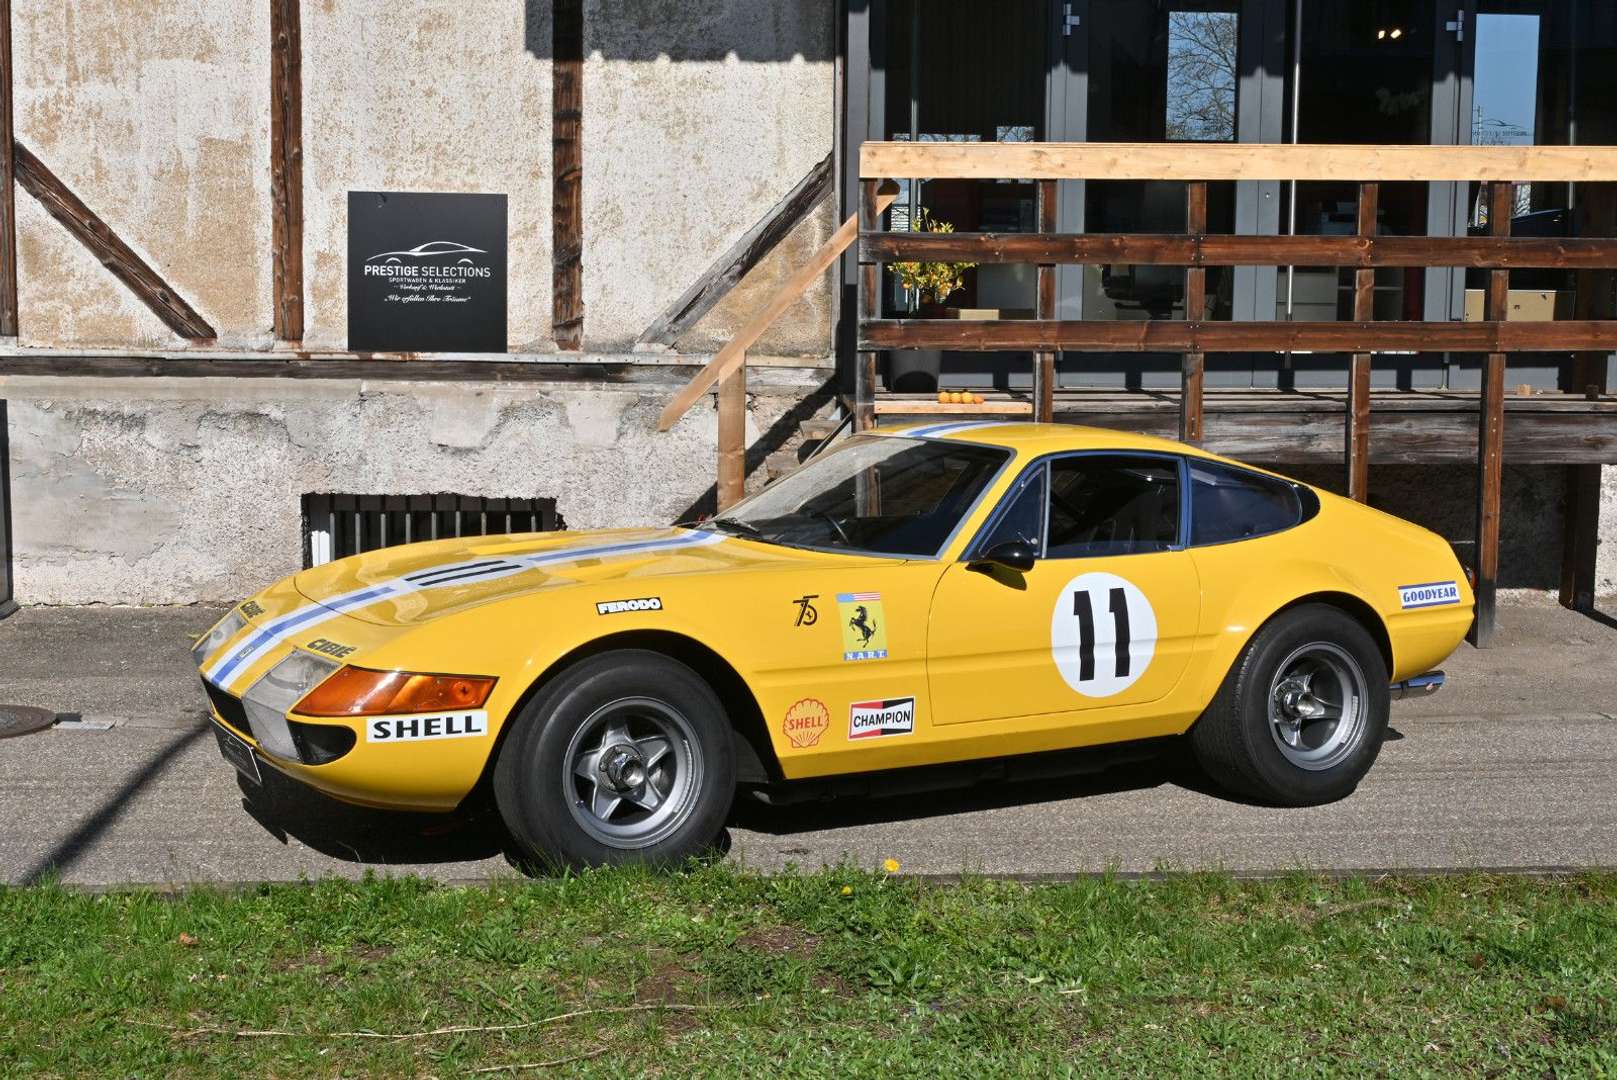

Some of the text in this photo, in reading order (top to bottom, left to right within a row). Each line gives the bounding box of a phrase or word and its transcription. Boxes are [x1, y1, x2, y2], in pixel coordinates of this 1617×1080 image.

[364, 265, 491, 278] PRESTIGE SELECTIONS
[1402, 587, 1457, 603] GOODYEAR
[597, 598, 661, 615] FERODO
[1073, 587, 1130, 682] 11
[373, 715, 482, 740] SHELL
[788, 715, 824, 731] SHELL
[853, 710, 911, 728] CHAMPION
